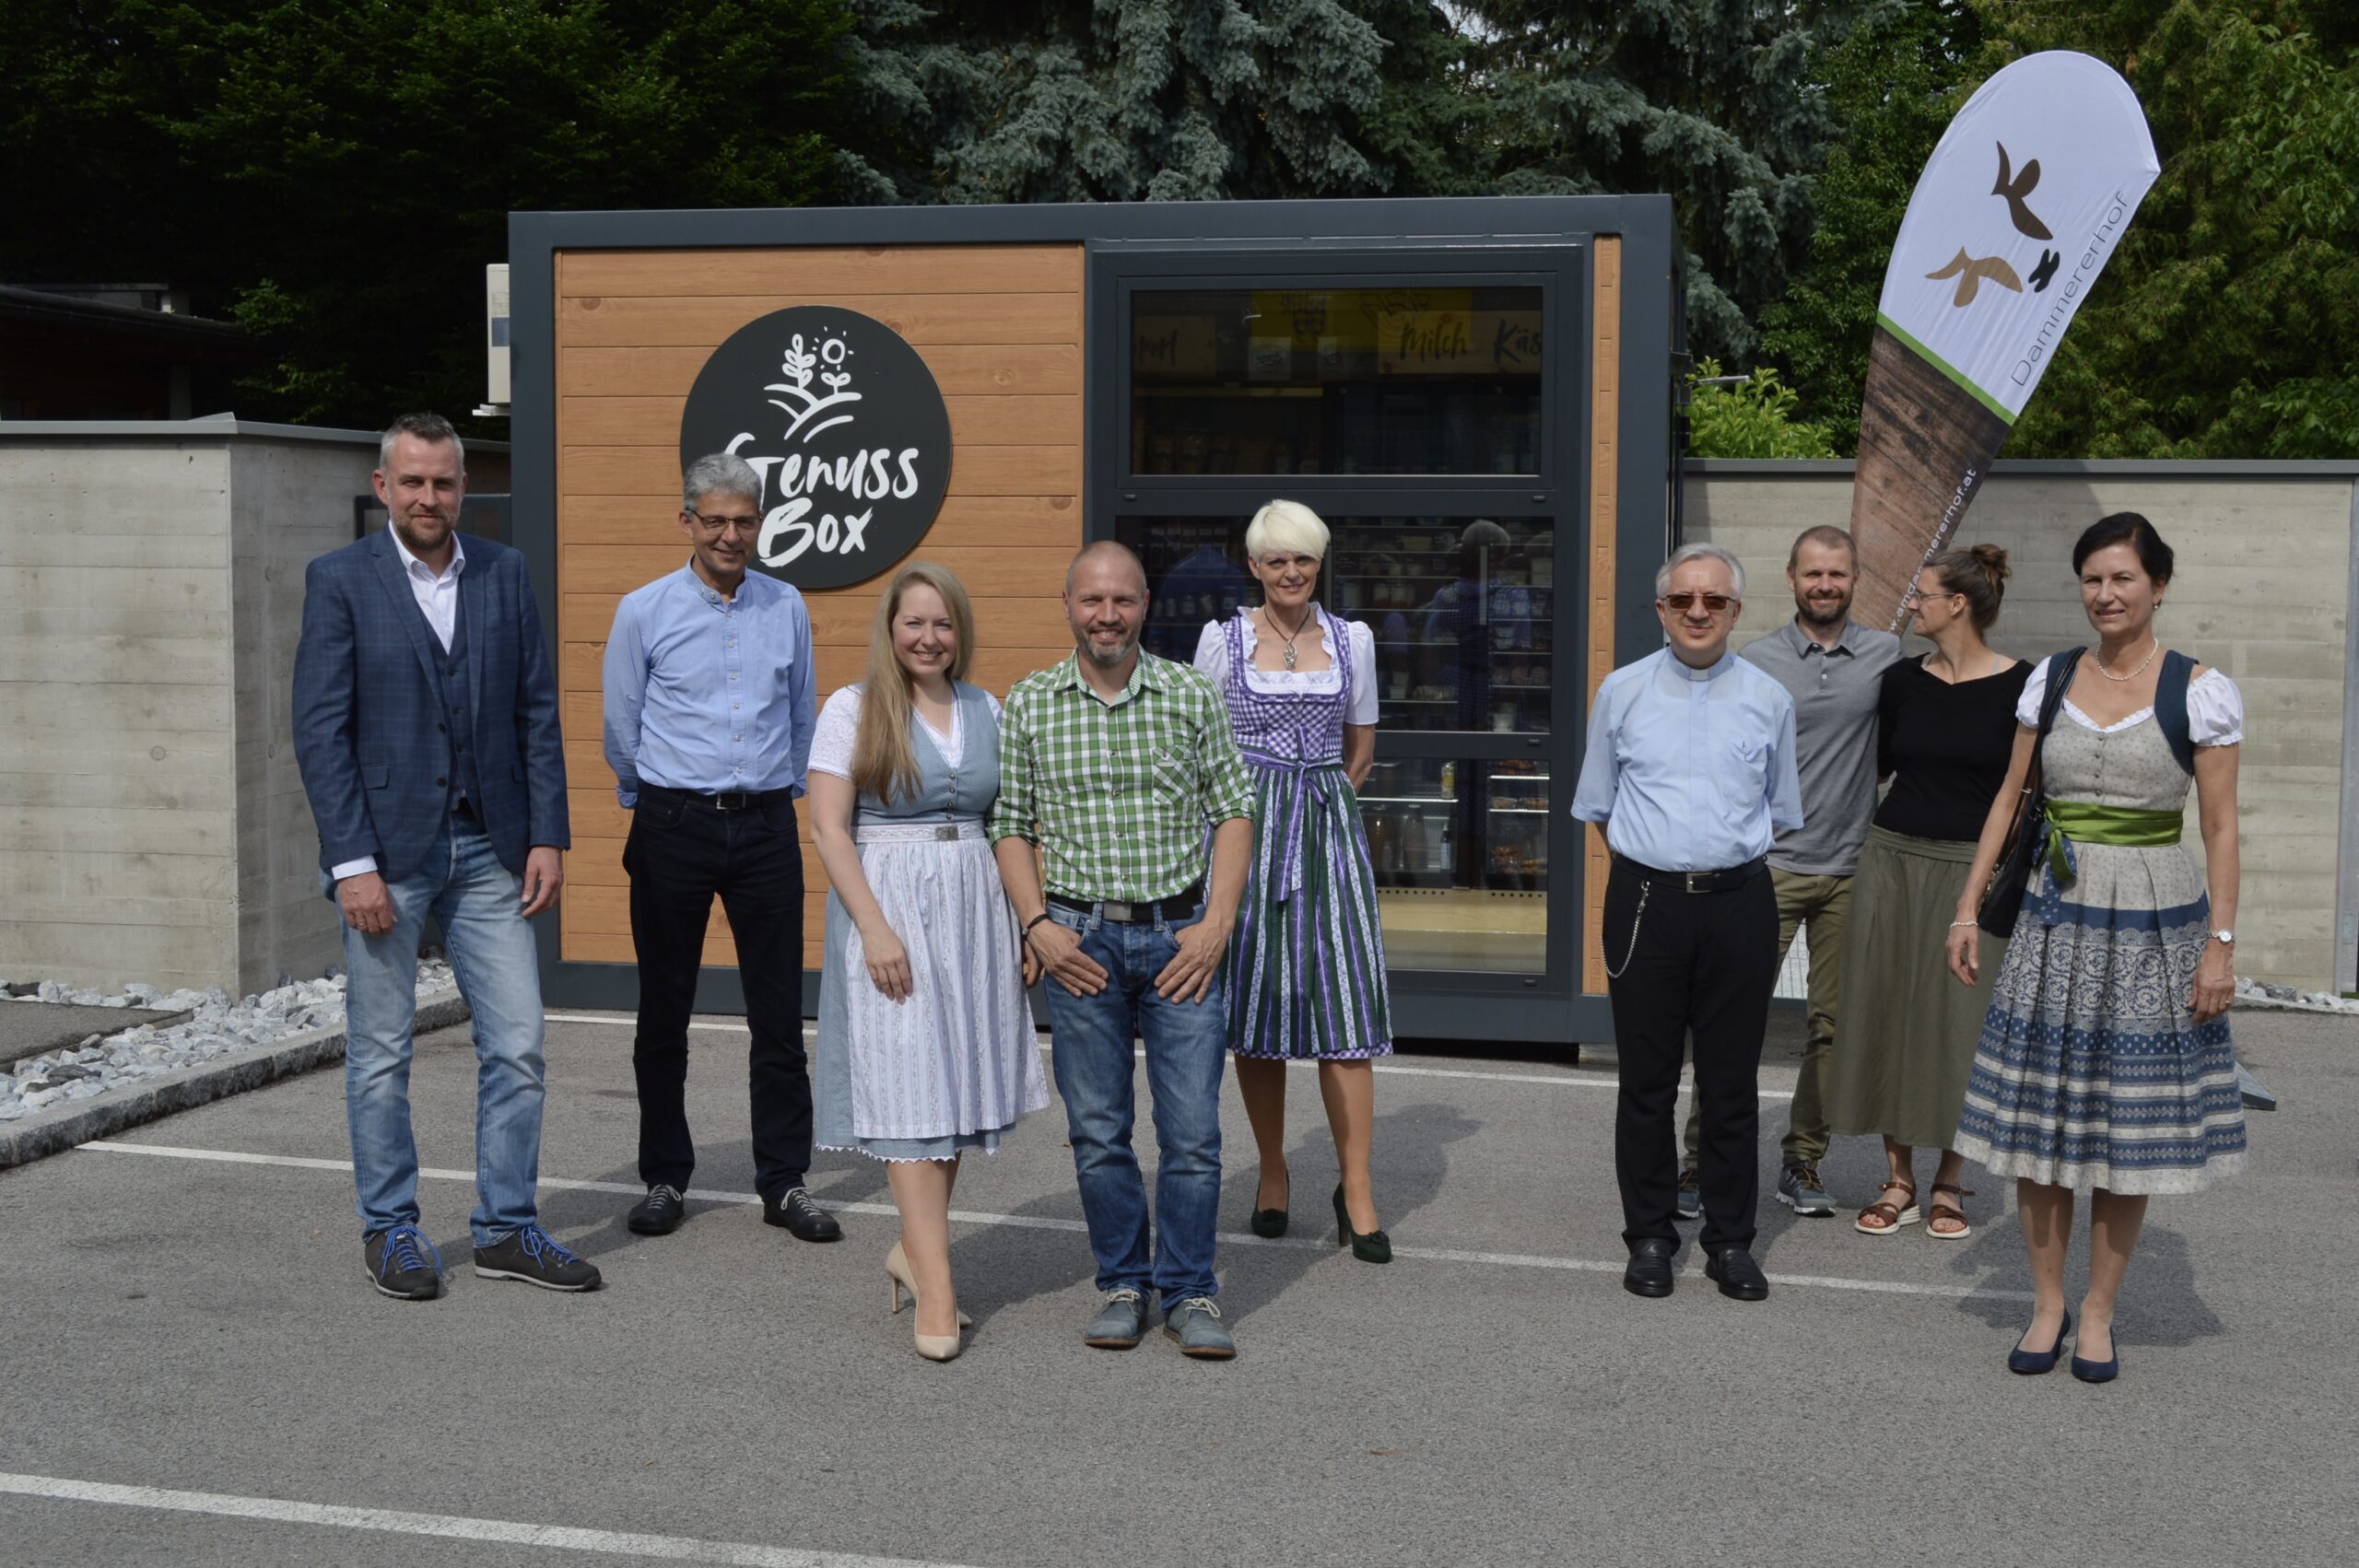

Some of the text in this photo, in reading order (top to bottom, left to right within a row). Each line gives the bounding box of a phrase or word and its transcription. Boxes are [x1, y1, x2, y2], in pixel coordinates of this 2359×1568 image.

[2010, 190, 2128, 386] Dammererhof
[1400, 321, 1467, 361] Milch
[757, 497, 873, 567] Box
